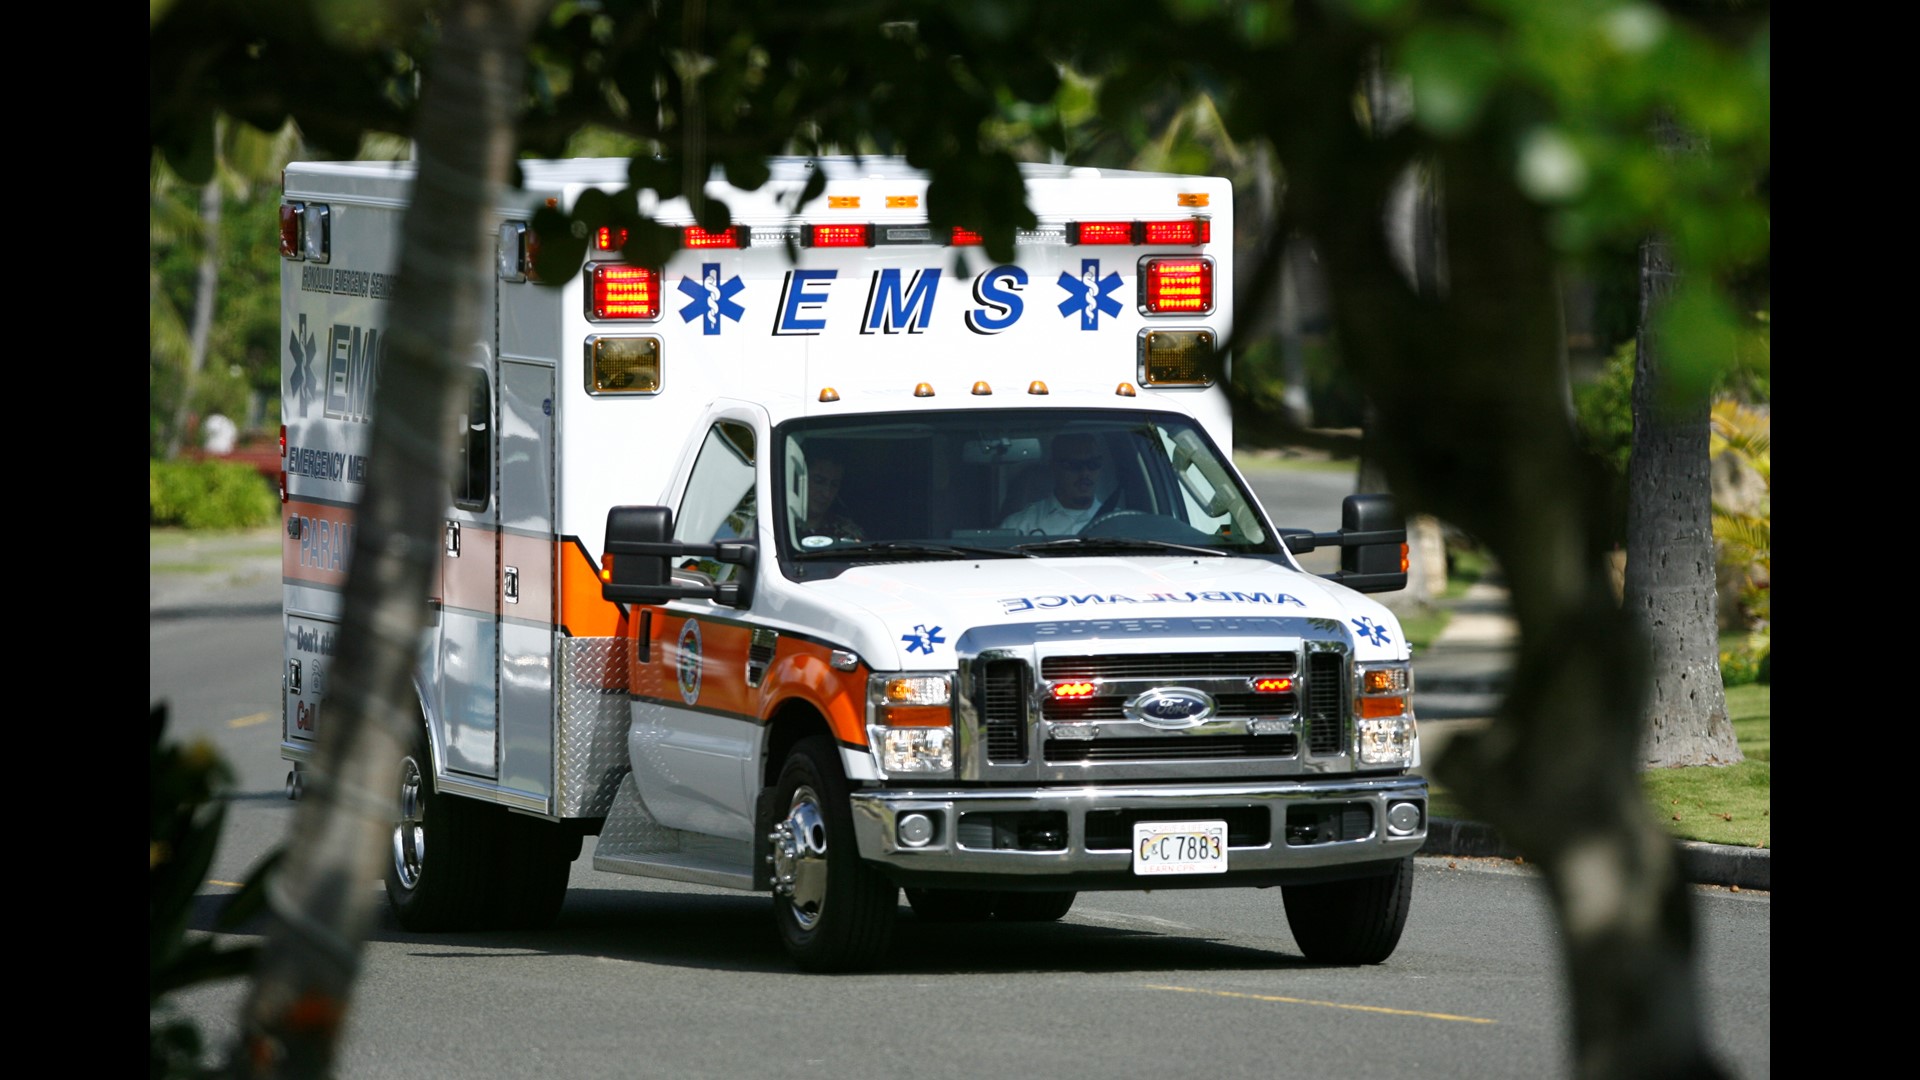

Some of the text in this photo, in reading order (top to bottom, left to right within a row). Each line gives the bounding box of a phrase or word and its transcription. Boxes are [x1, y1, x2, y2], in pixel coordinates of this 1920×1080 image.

[302, 265, 333, 294] HONOLULU
[333, 268, 371, 298] EMERGENCY
[771, 264, 1029, 337] EMS
[323, 324, 386, 424] EM
[288, 446, 346, 481] EMERGENCY
[1035, 618, 1291, 636] SUPER DUTY
[1156, 698, 1193, 714] Ford
[1176, 836, 1221, 860] 7883
